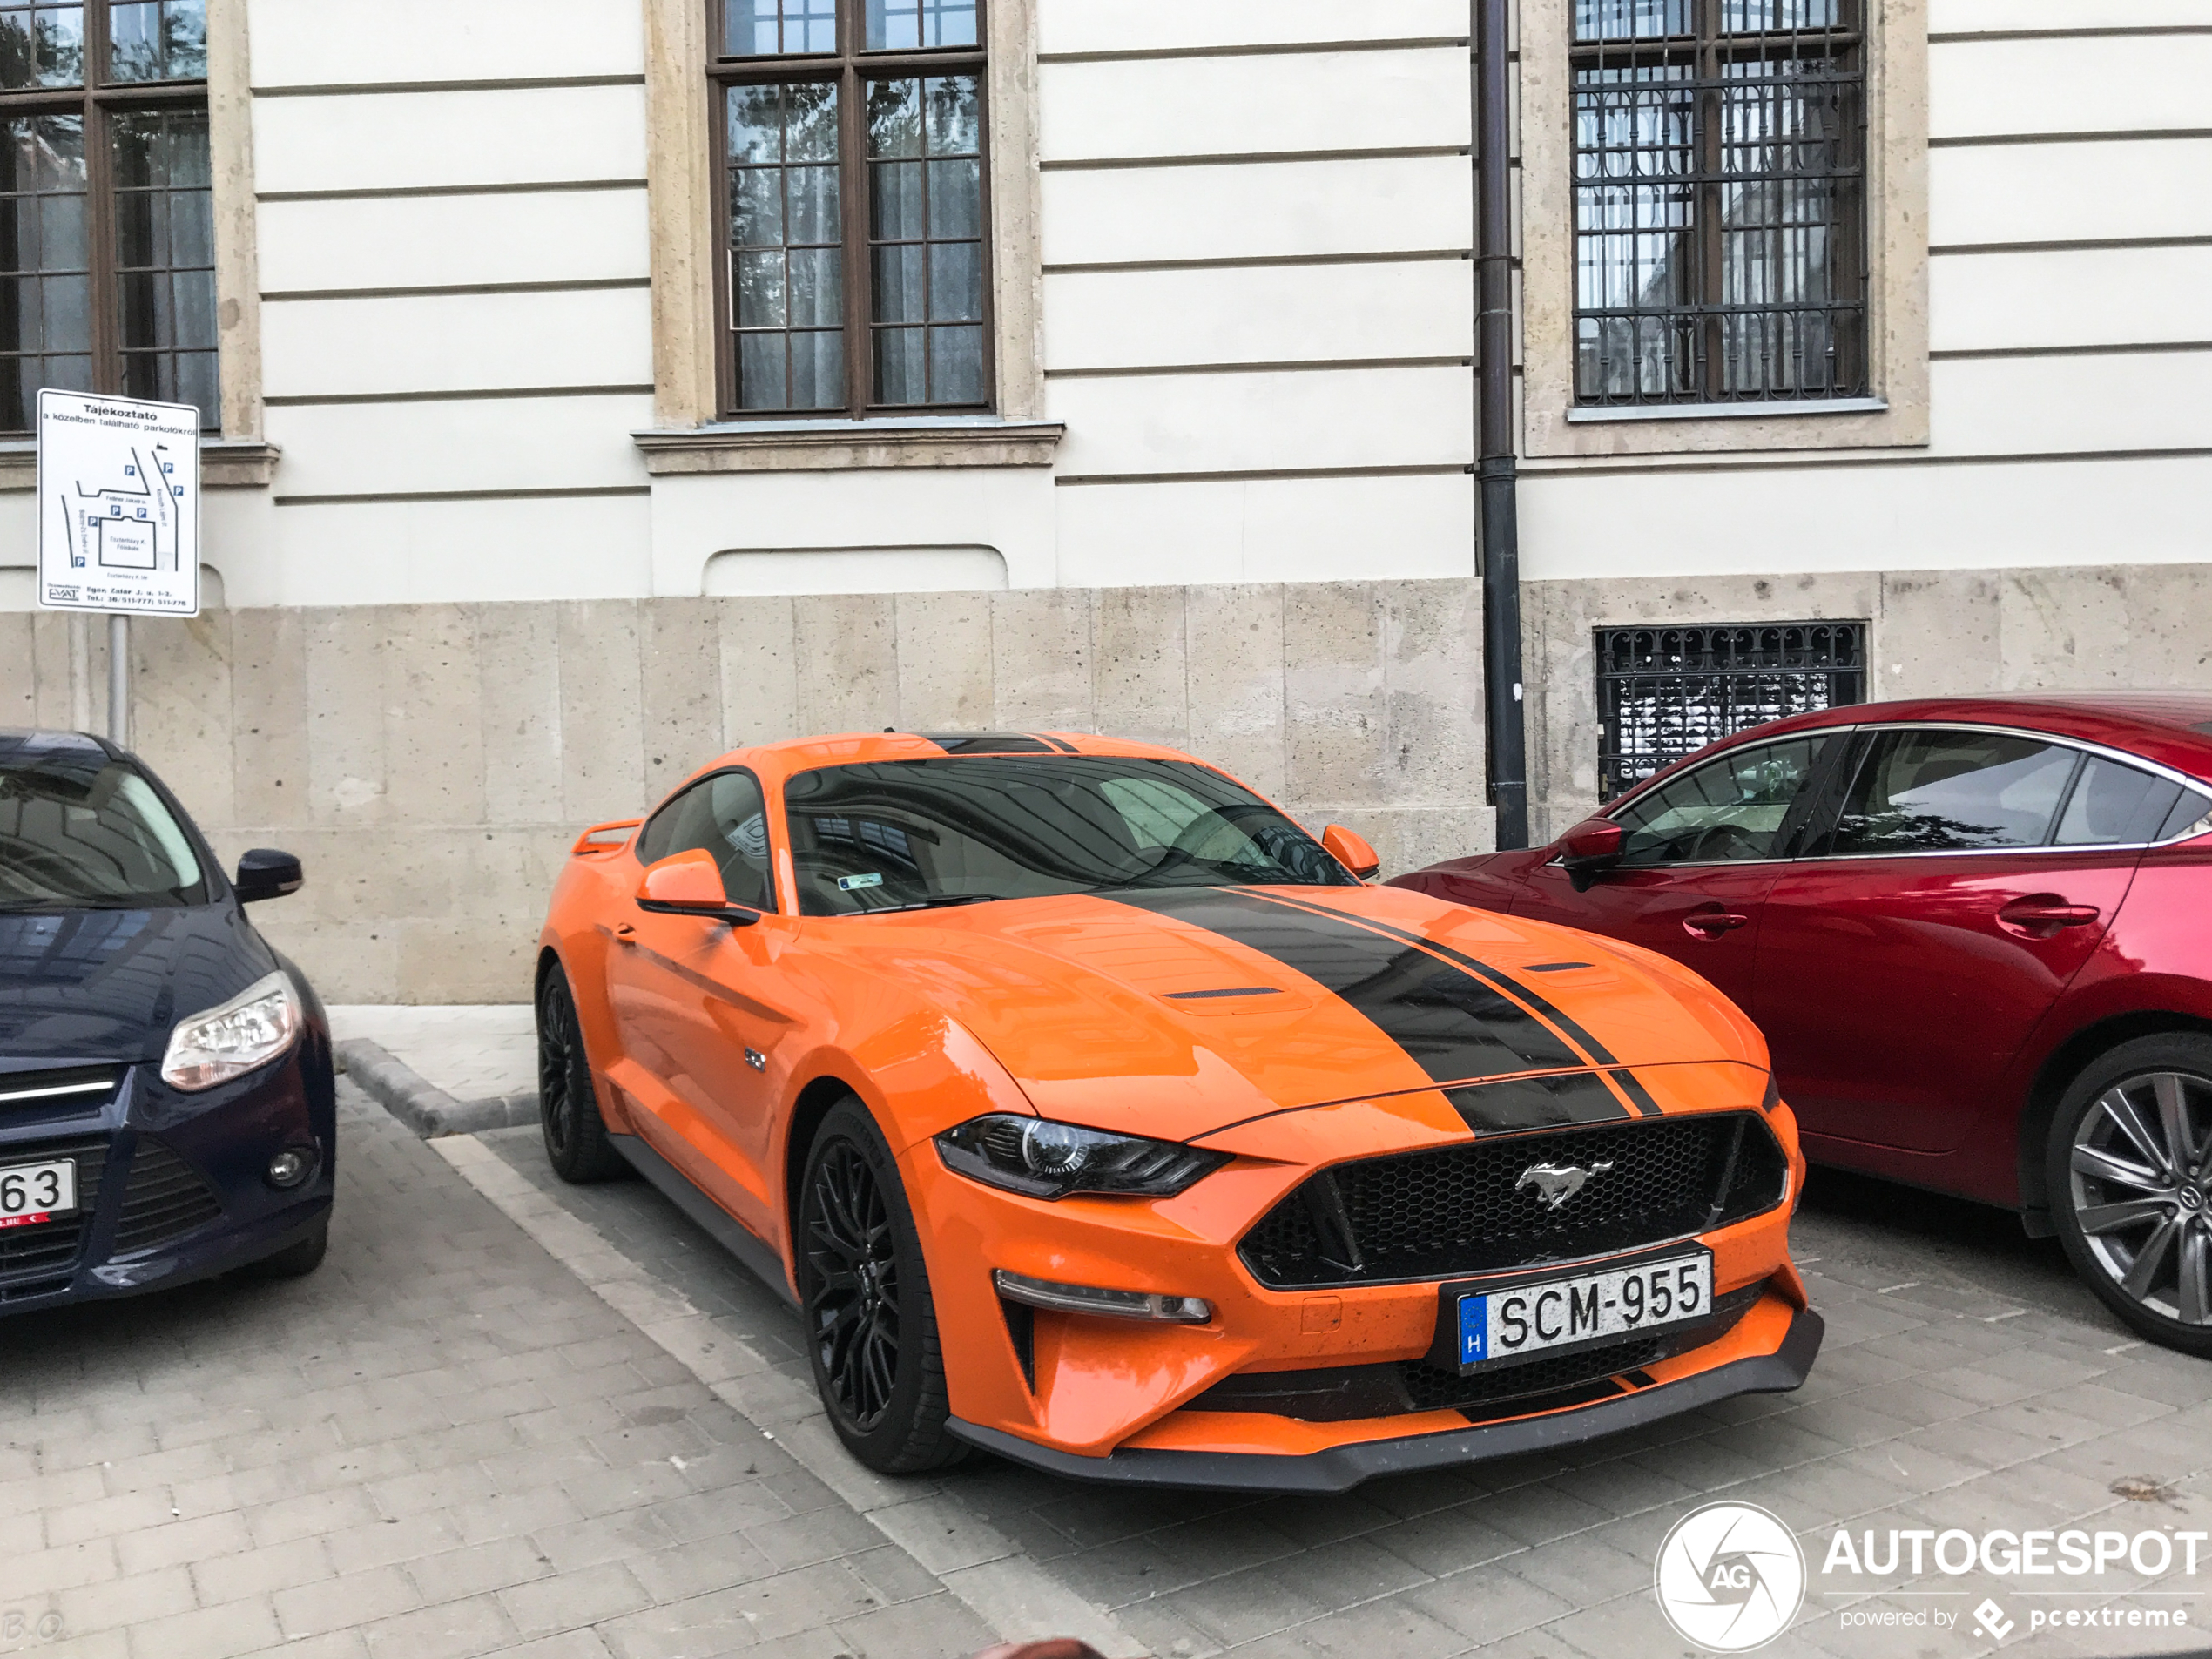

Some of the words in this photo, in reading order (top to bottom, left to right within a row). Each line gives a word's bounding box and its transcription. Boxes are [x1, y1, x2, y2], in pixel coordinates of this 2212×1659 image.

[52, 413, 95, 425] közelben
[99, 419, 139, 430] található
[84, 404, 158, 421] Tájékoztató
[1500, 1264, 1701, 1349] SCM-955
[1467, 1333, 1480, 1353] H
